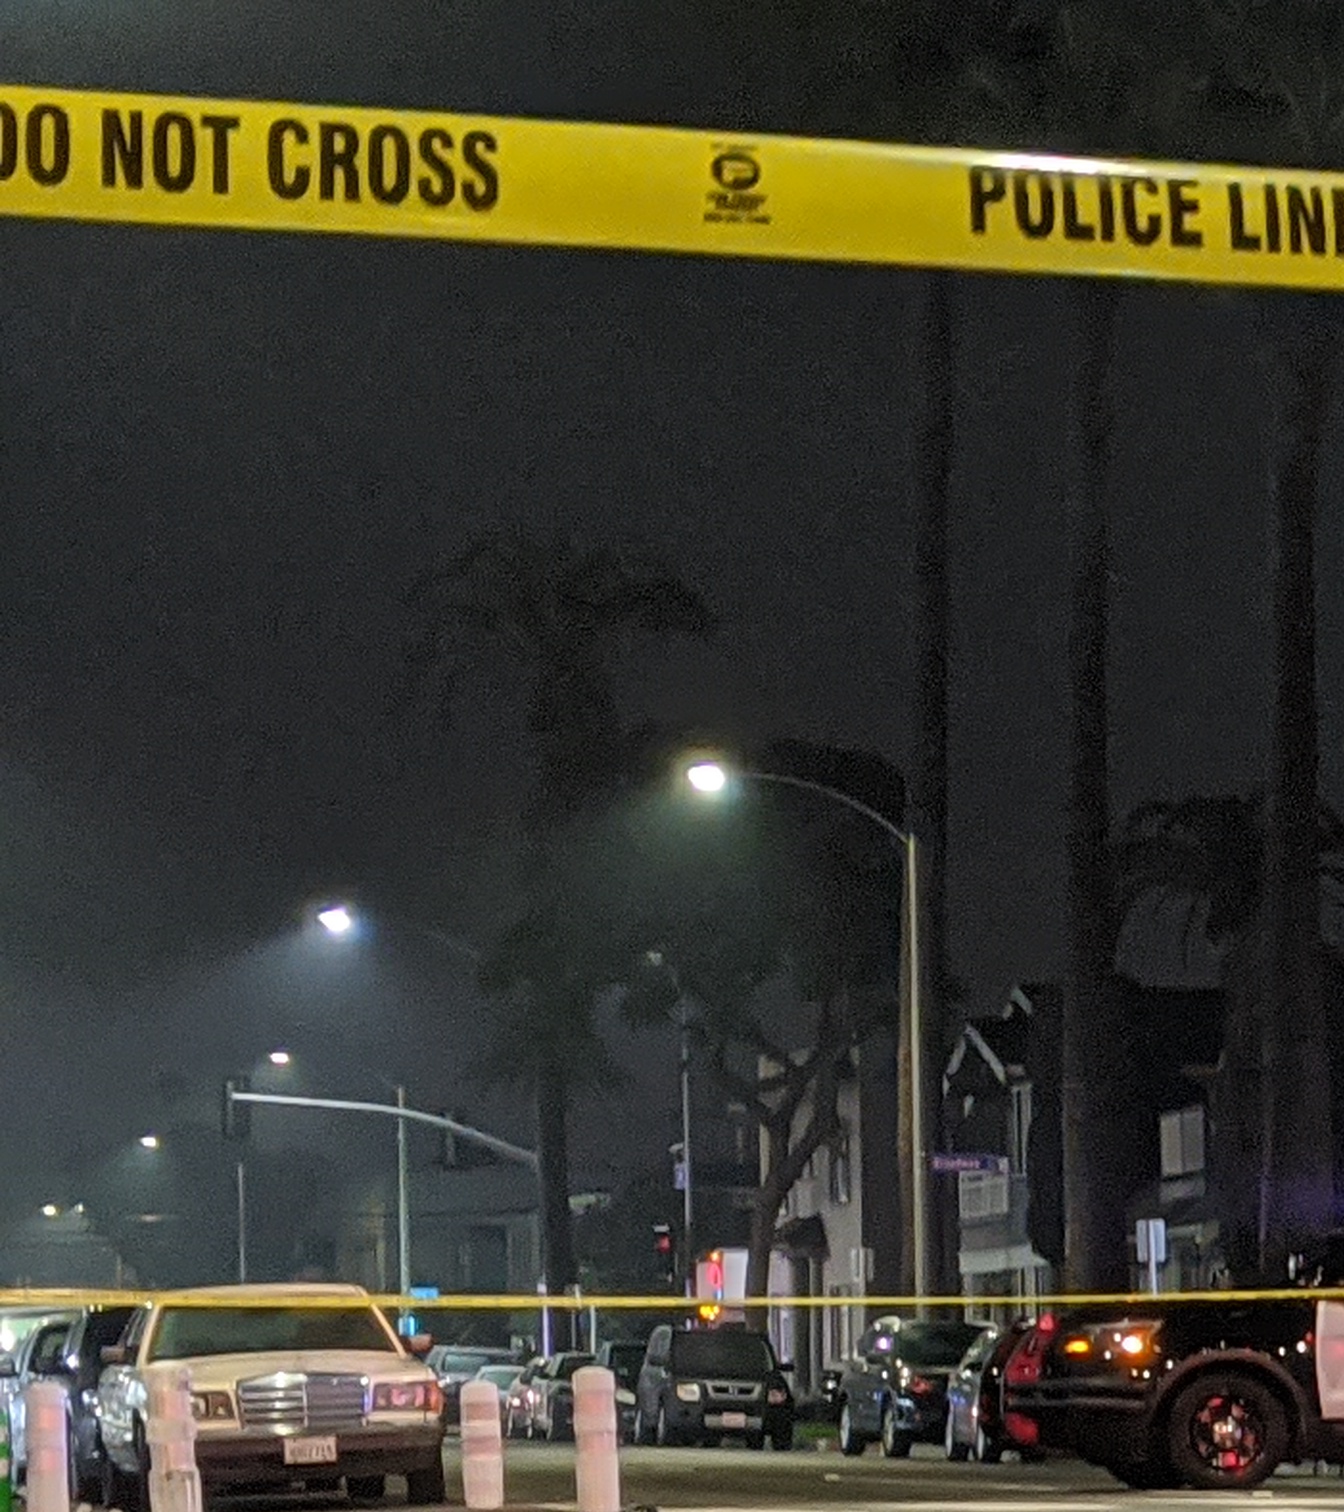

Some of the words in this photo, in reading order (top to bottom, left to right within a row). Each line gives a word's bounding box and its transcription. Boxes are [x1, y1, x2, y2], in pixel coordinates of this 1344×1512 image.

[101, 108, 240, 195] NOT
[267, 118, 499, 212] CROSS
[969, 166, 1203, 247] POLICE
